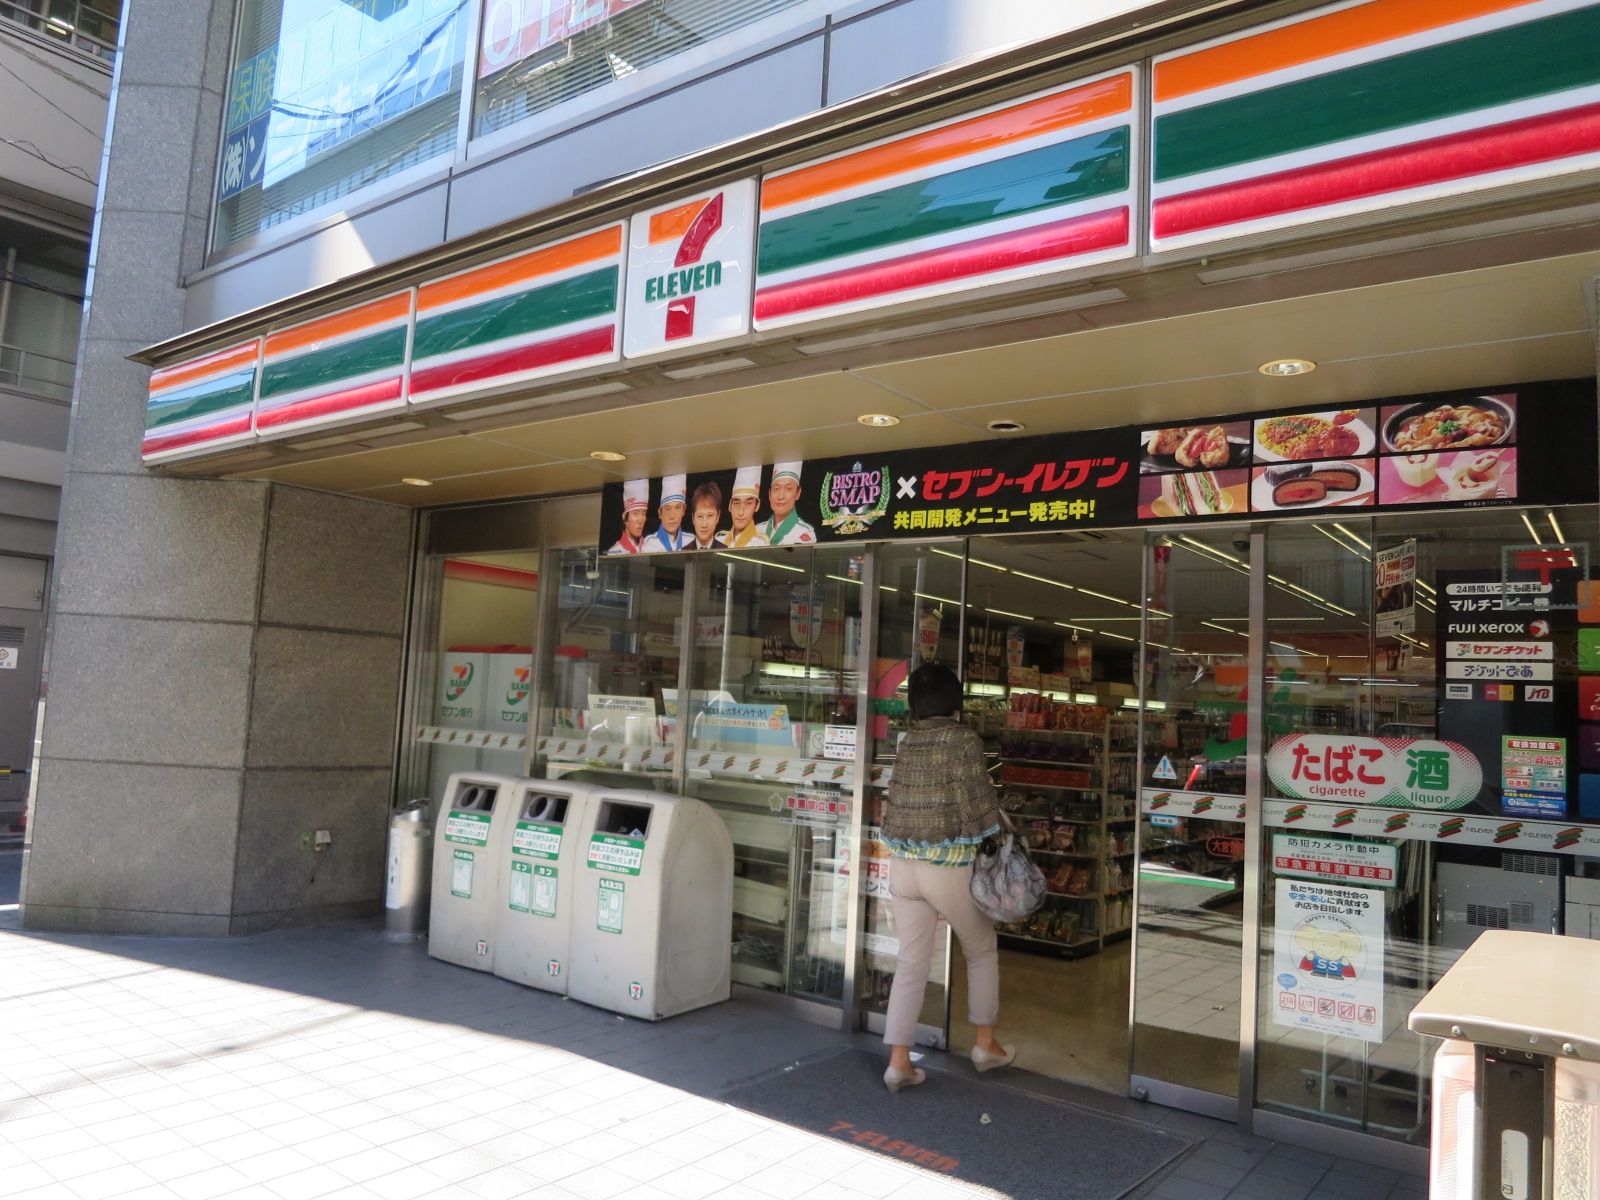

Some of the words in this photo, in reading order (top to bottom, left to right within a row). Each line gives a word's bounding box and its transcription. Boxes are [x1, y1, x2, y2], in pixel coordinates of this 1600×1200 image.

[831, 470, 881, 490] BISTRO
[829, 485, 880, 507] SMAP
[893, 499, 1096, 531] 共同開発メニュー発売中!
[1448, 623, 1476, 633] FUJI
[1473, 644, 1544, 655] セブンチケット
[1463, 664, 1534, 678] チケットぴあ
[1291, 743, 1386, 785] たばこ
[1405, 748, 1450, 791] 酒
[1309, 785, 1367, 799] cigarette
[1410, 791, 1451, 805] liquor
[1287, 837, 1380, 854] 防犯カメラ作動中
[1276, 856, 1392, 881] 緊急通報装置設置
[1290, 884, 1369, 900] 私たちは地域社会の
[1294, 901, 1366, 917] お店を目指します。
[1316, 960, 1339, 970] SS
